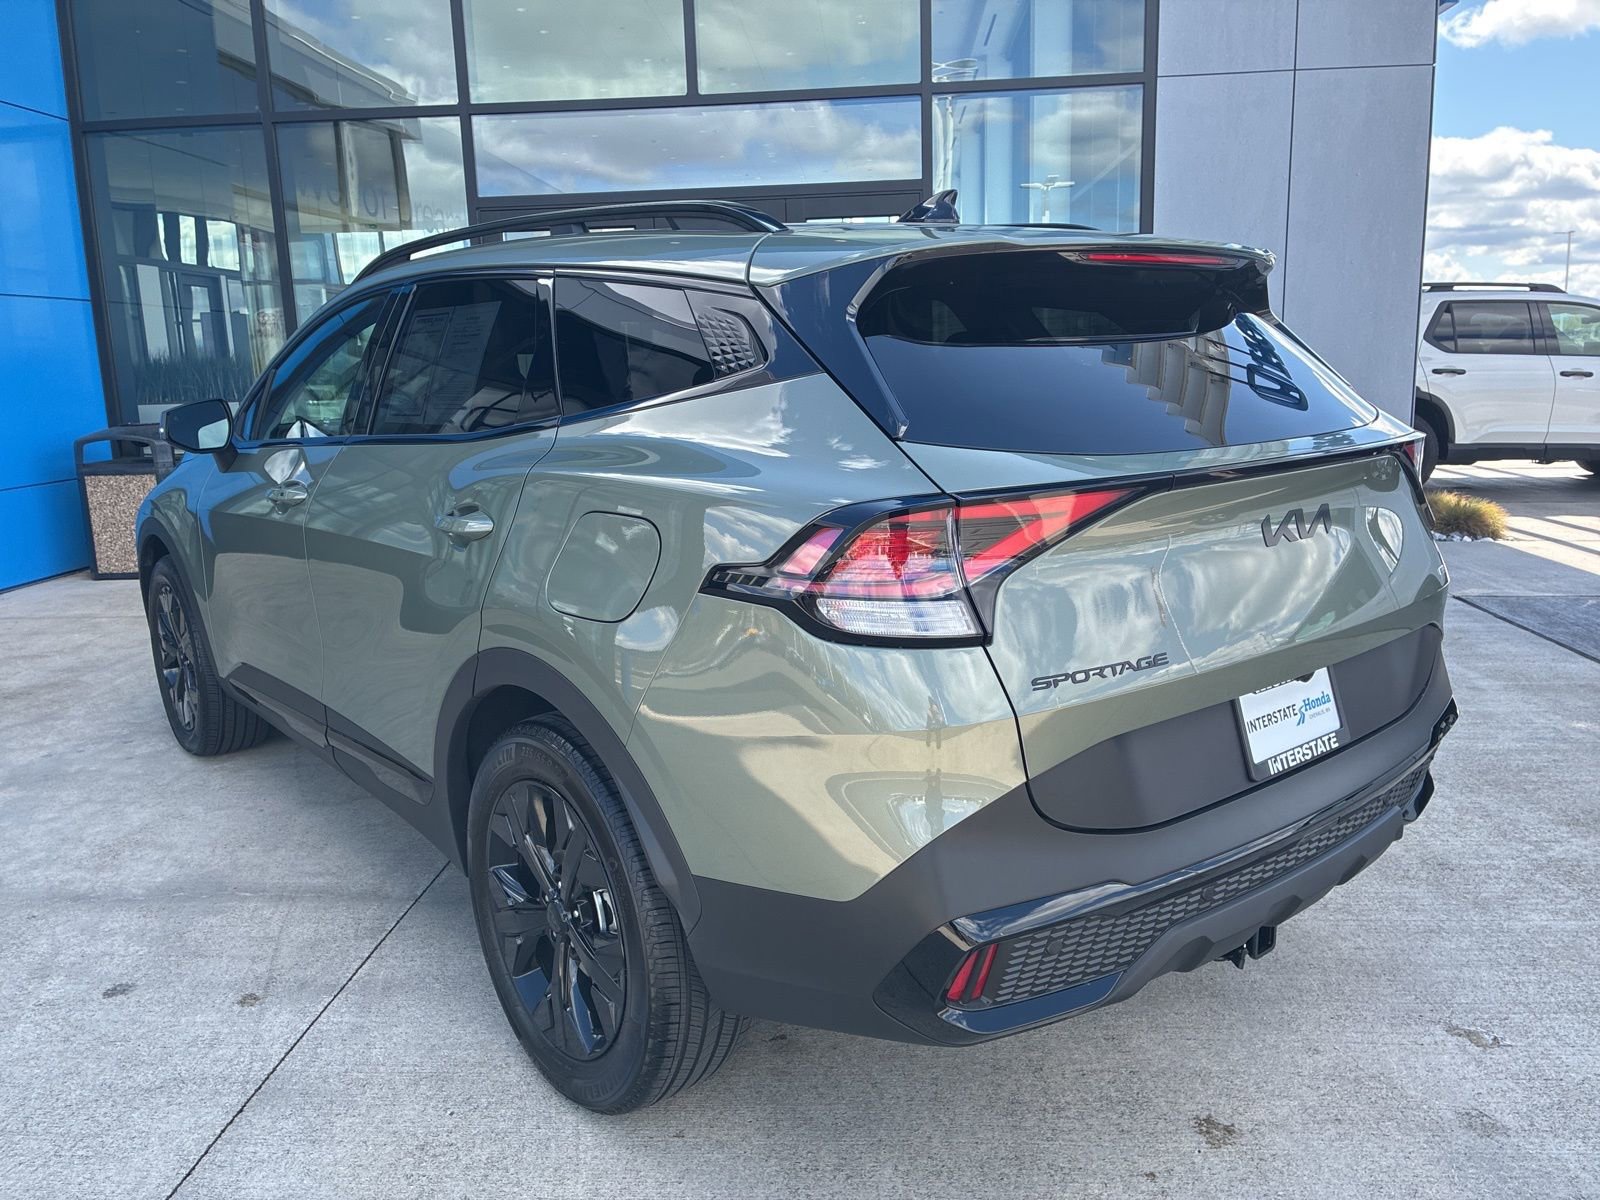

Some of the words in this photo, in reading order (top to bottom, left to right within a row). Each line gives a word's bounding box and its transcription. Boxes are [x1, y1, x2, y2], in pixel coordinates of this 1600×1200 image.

[1261, 503, 1332, 547] KIA
[1031, 652, 1170, 691] SPORTAGE
[1246, 703, 1298, 734] INTERSTATE
[1303, 691, 1332, 712] Honda
[1267, 732, 1340, 775] INTERSTATE
